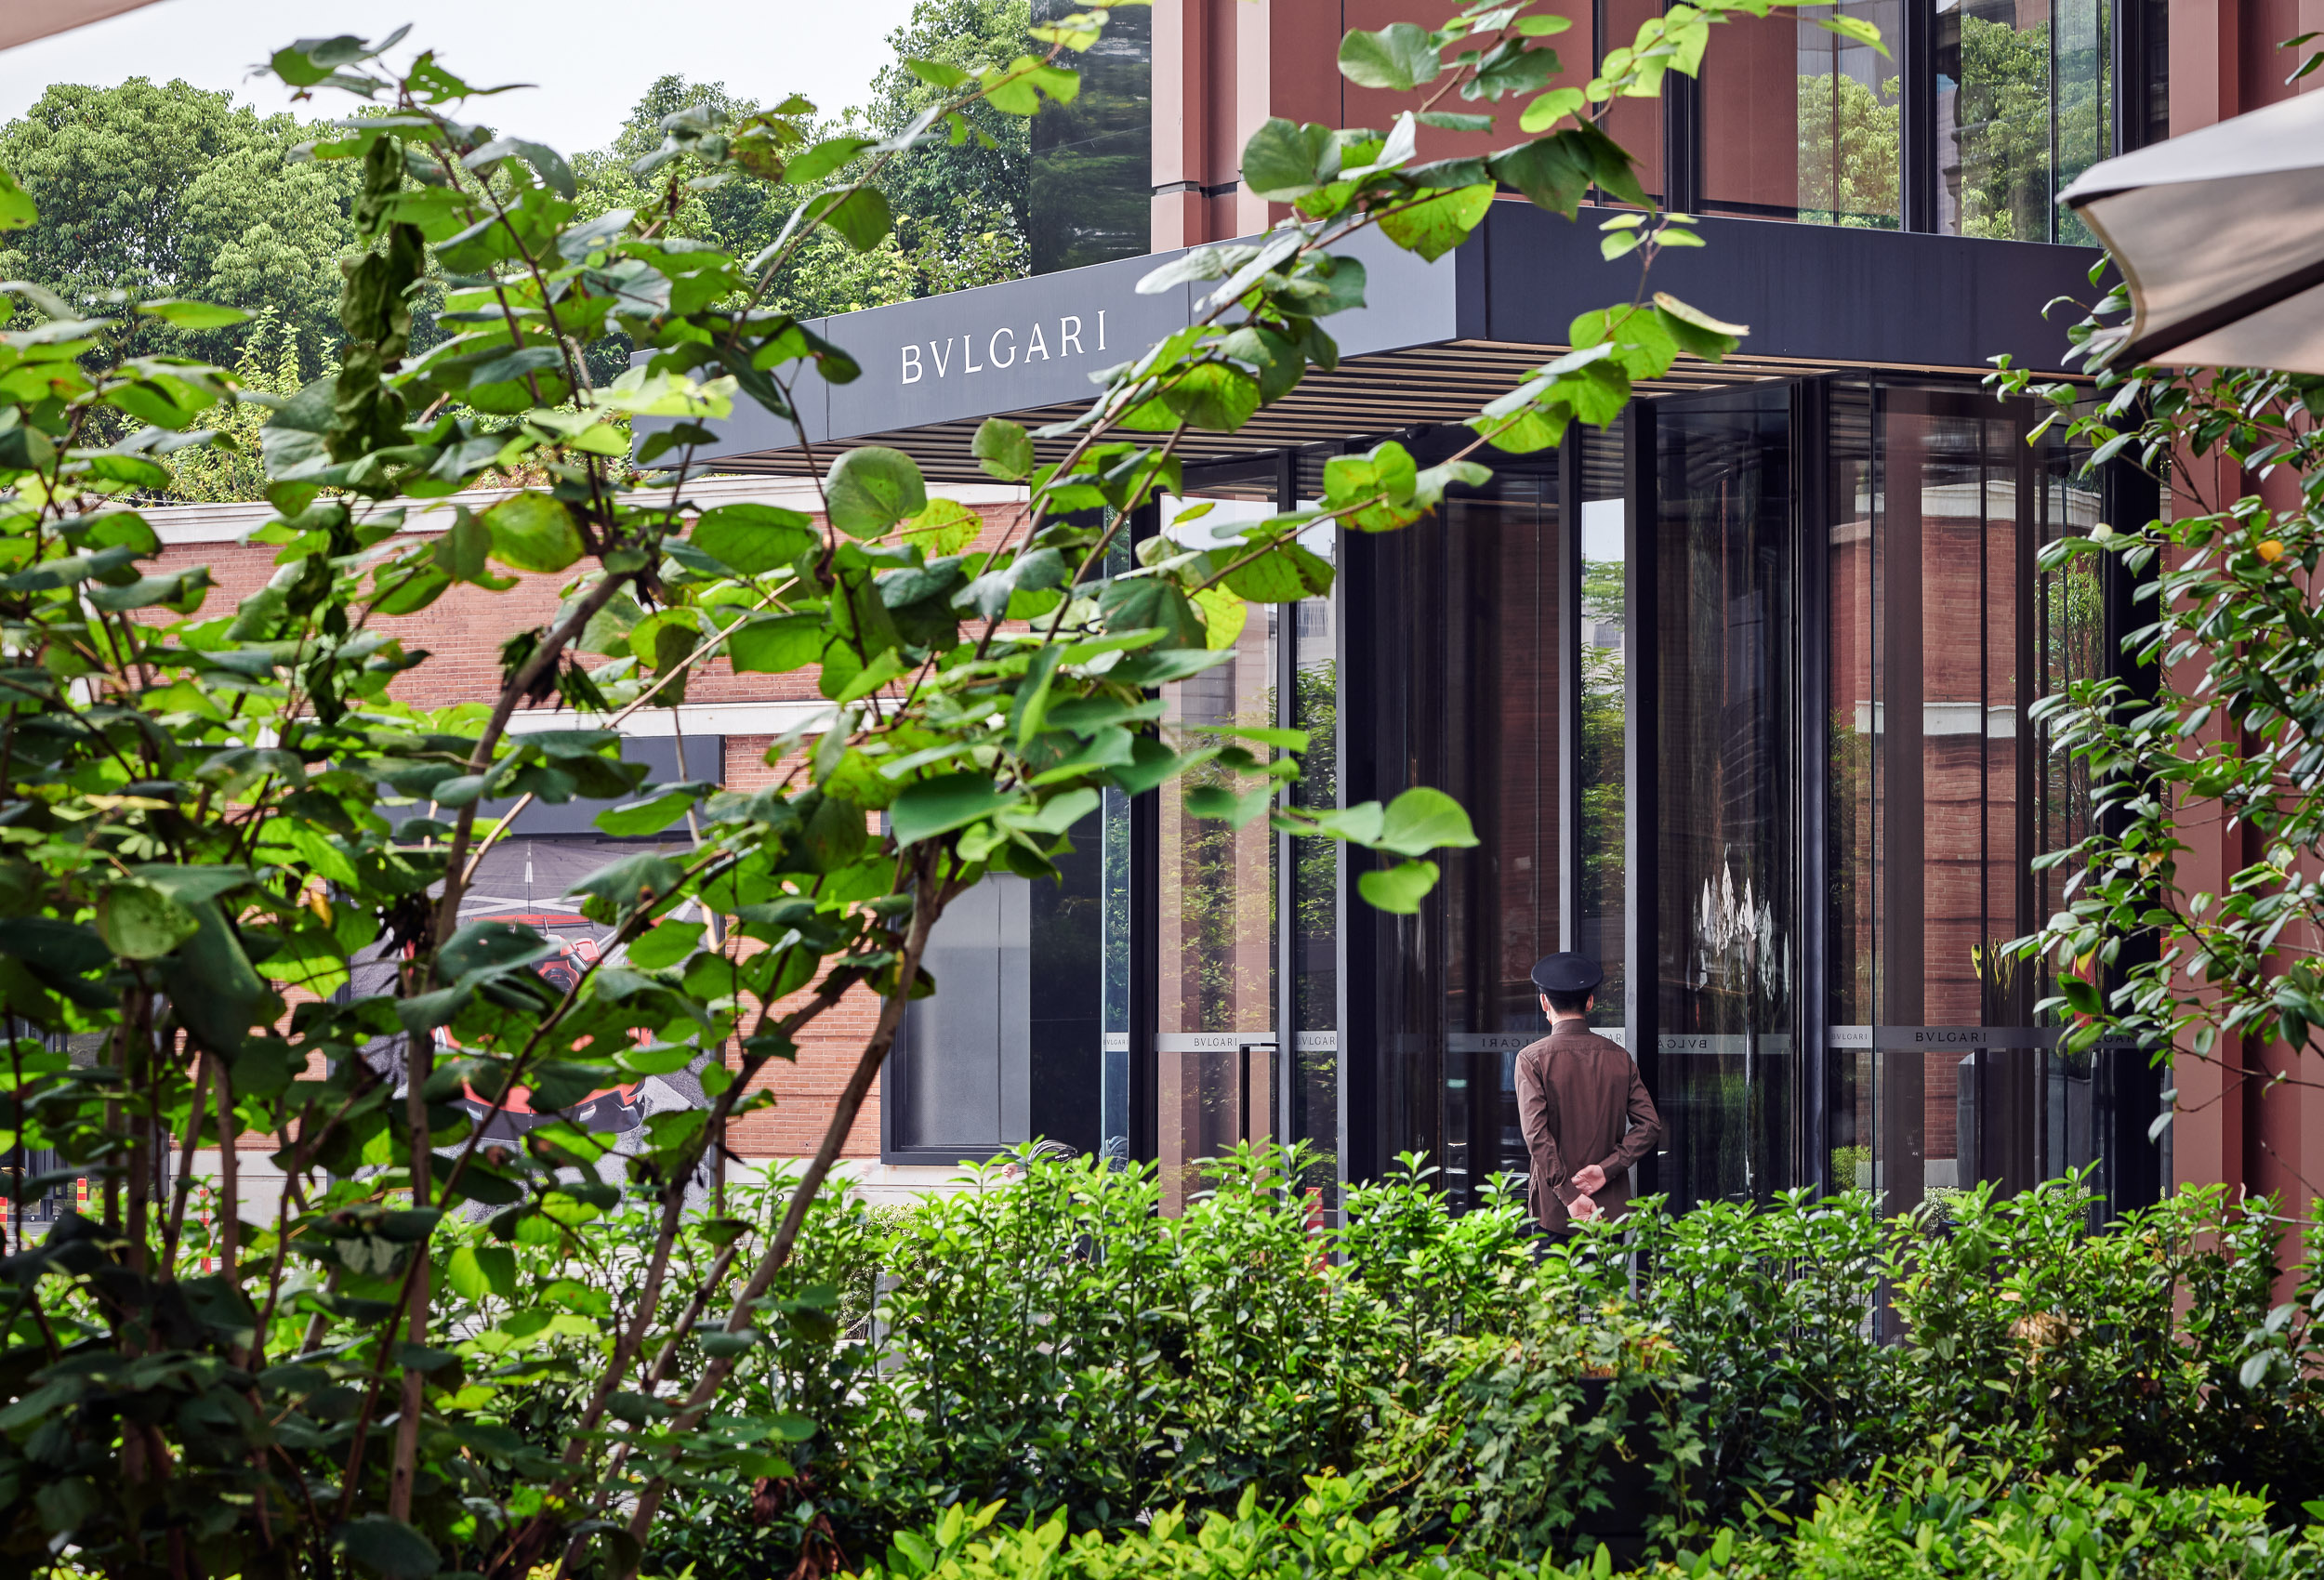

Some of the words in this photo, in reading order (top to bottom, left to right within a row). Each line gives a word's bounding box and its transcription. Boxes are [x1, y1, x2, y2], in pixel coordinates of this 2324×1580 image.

[901, 309, 1106, 385] BVLGARI
[1194, 1037, 1237, 1047] BVLGARI
[1915, 1032, 1987, 1043] BVLGARI
